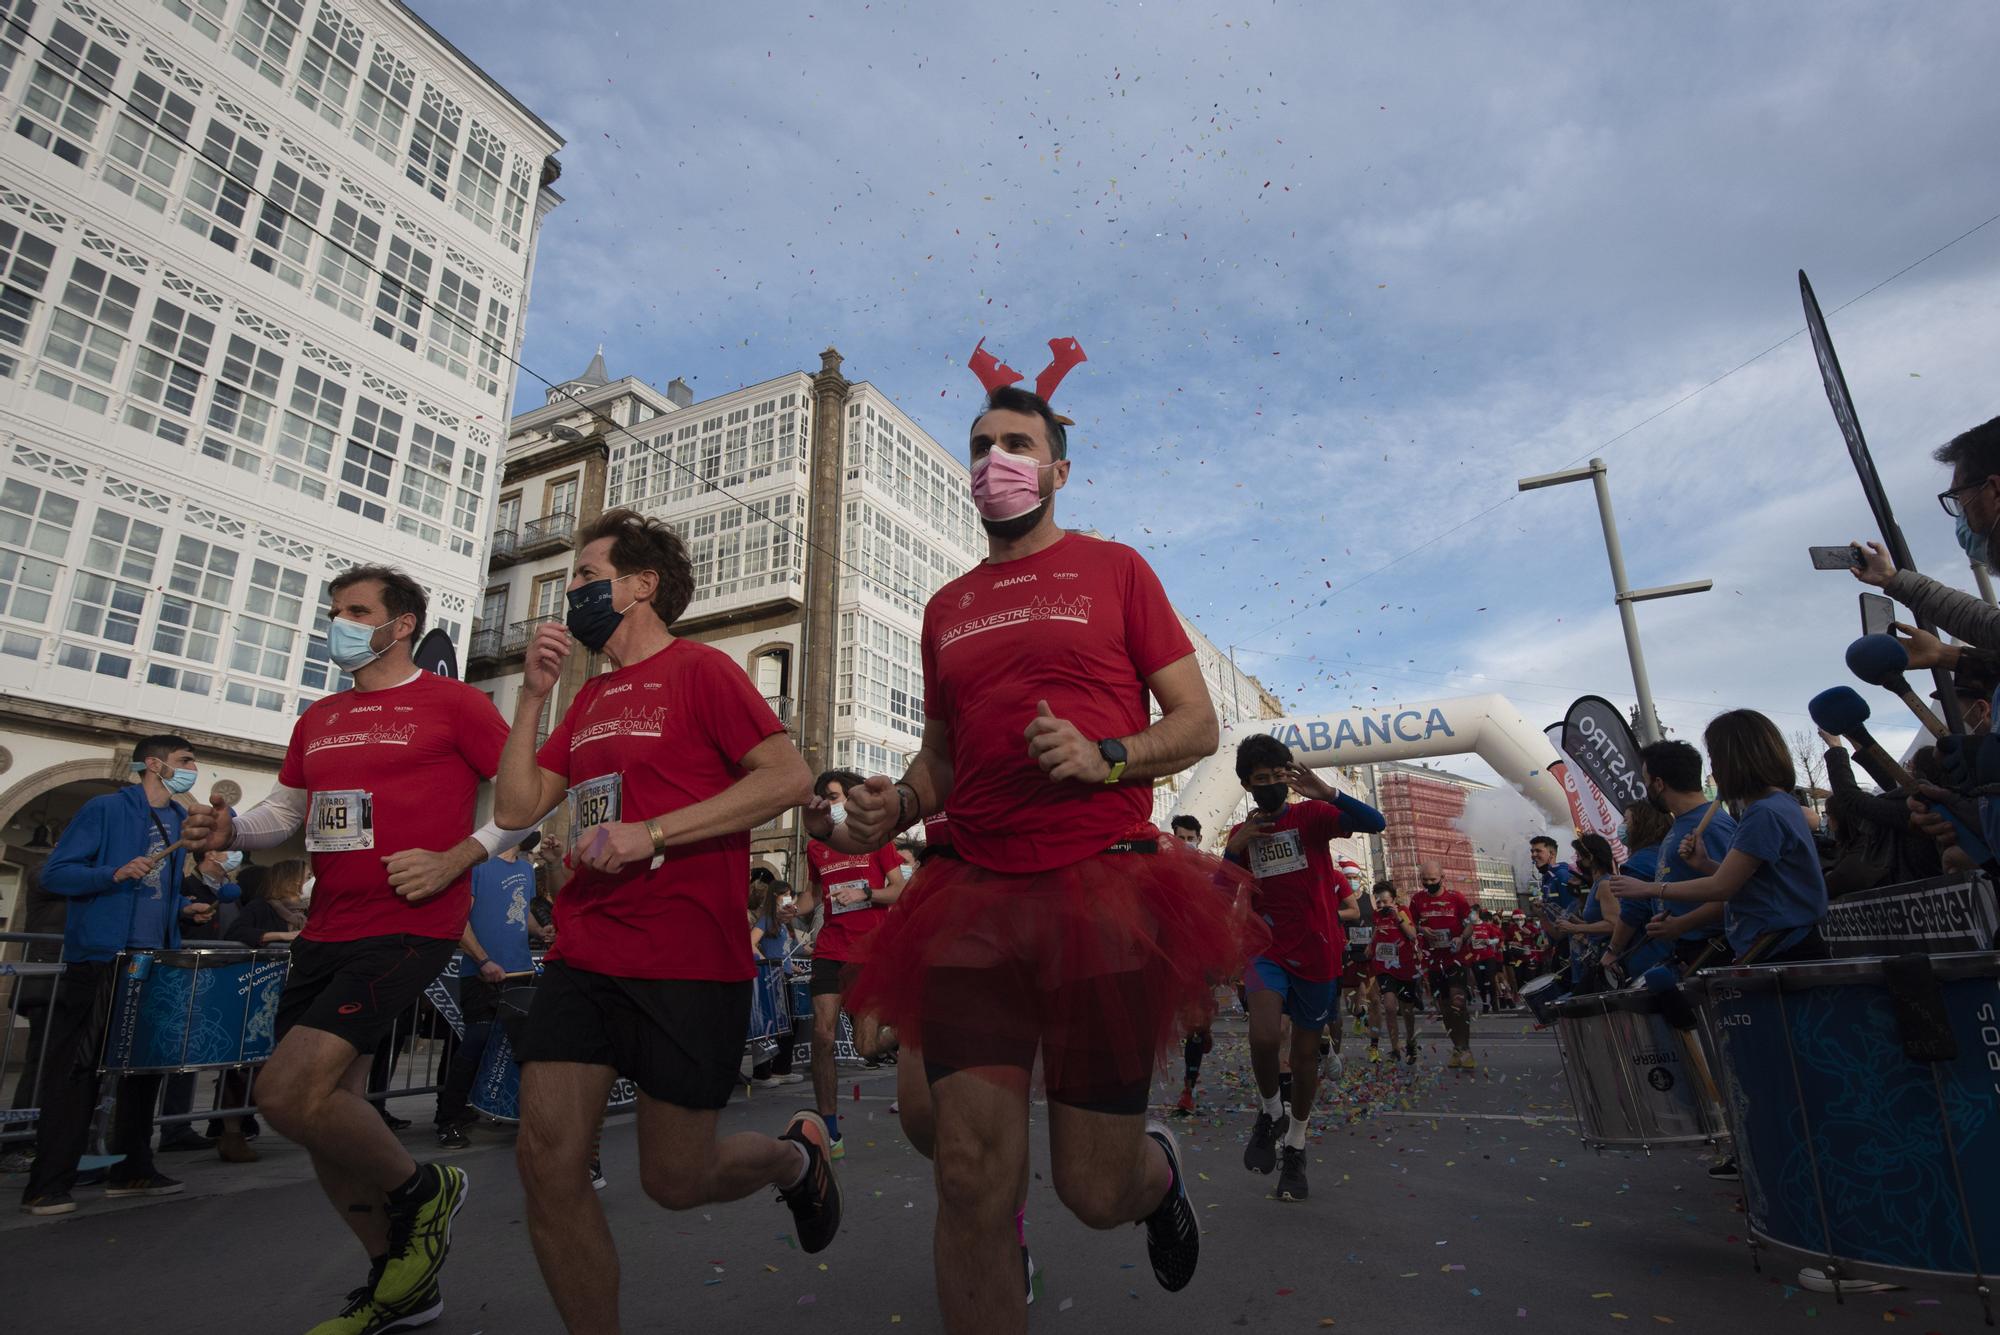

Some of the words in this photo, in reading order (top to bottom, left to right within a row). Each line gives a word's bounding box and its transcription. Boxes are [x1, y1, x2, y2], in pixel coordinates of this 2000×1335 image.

[993, 574, 1038, 590] ABANCA
[941, 627, 962, 644] SAN
[350, 705, 383, 713] ABANCA
[318, 807, 347, 830] 1149
[580, 795, 609, 829] 1982
[1259, 842, 1293, 862] 3506
[1632, 1051, 1679, 1066] TIMBRA
